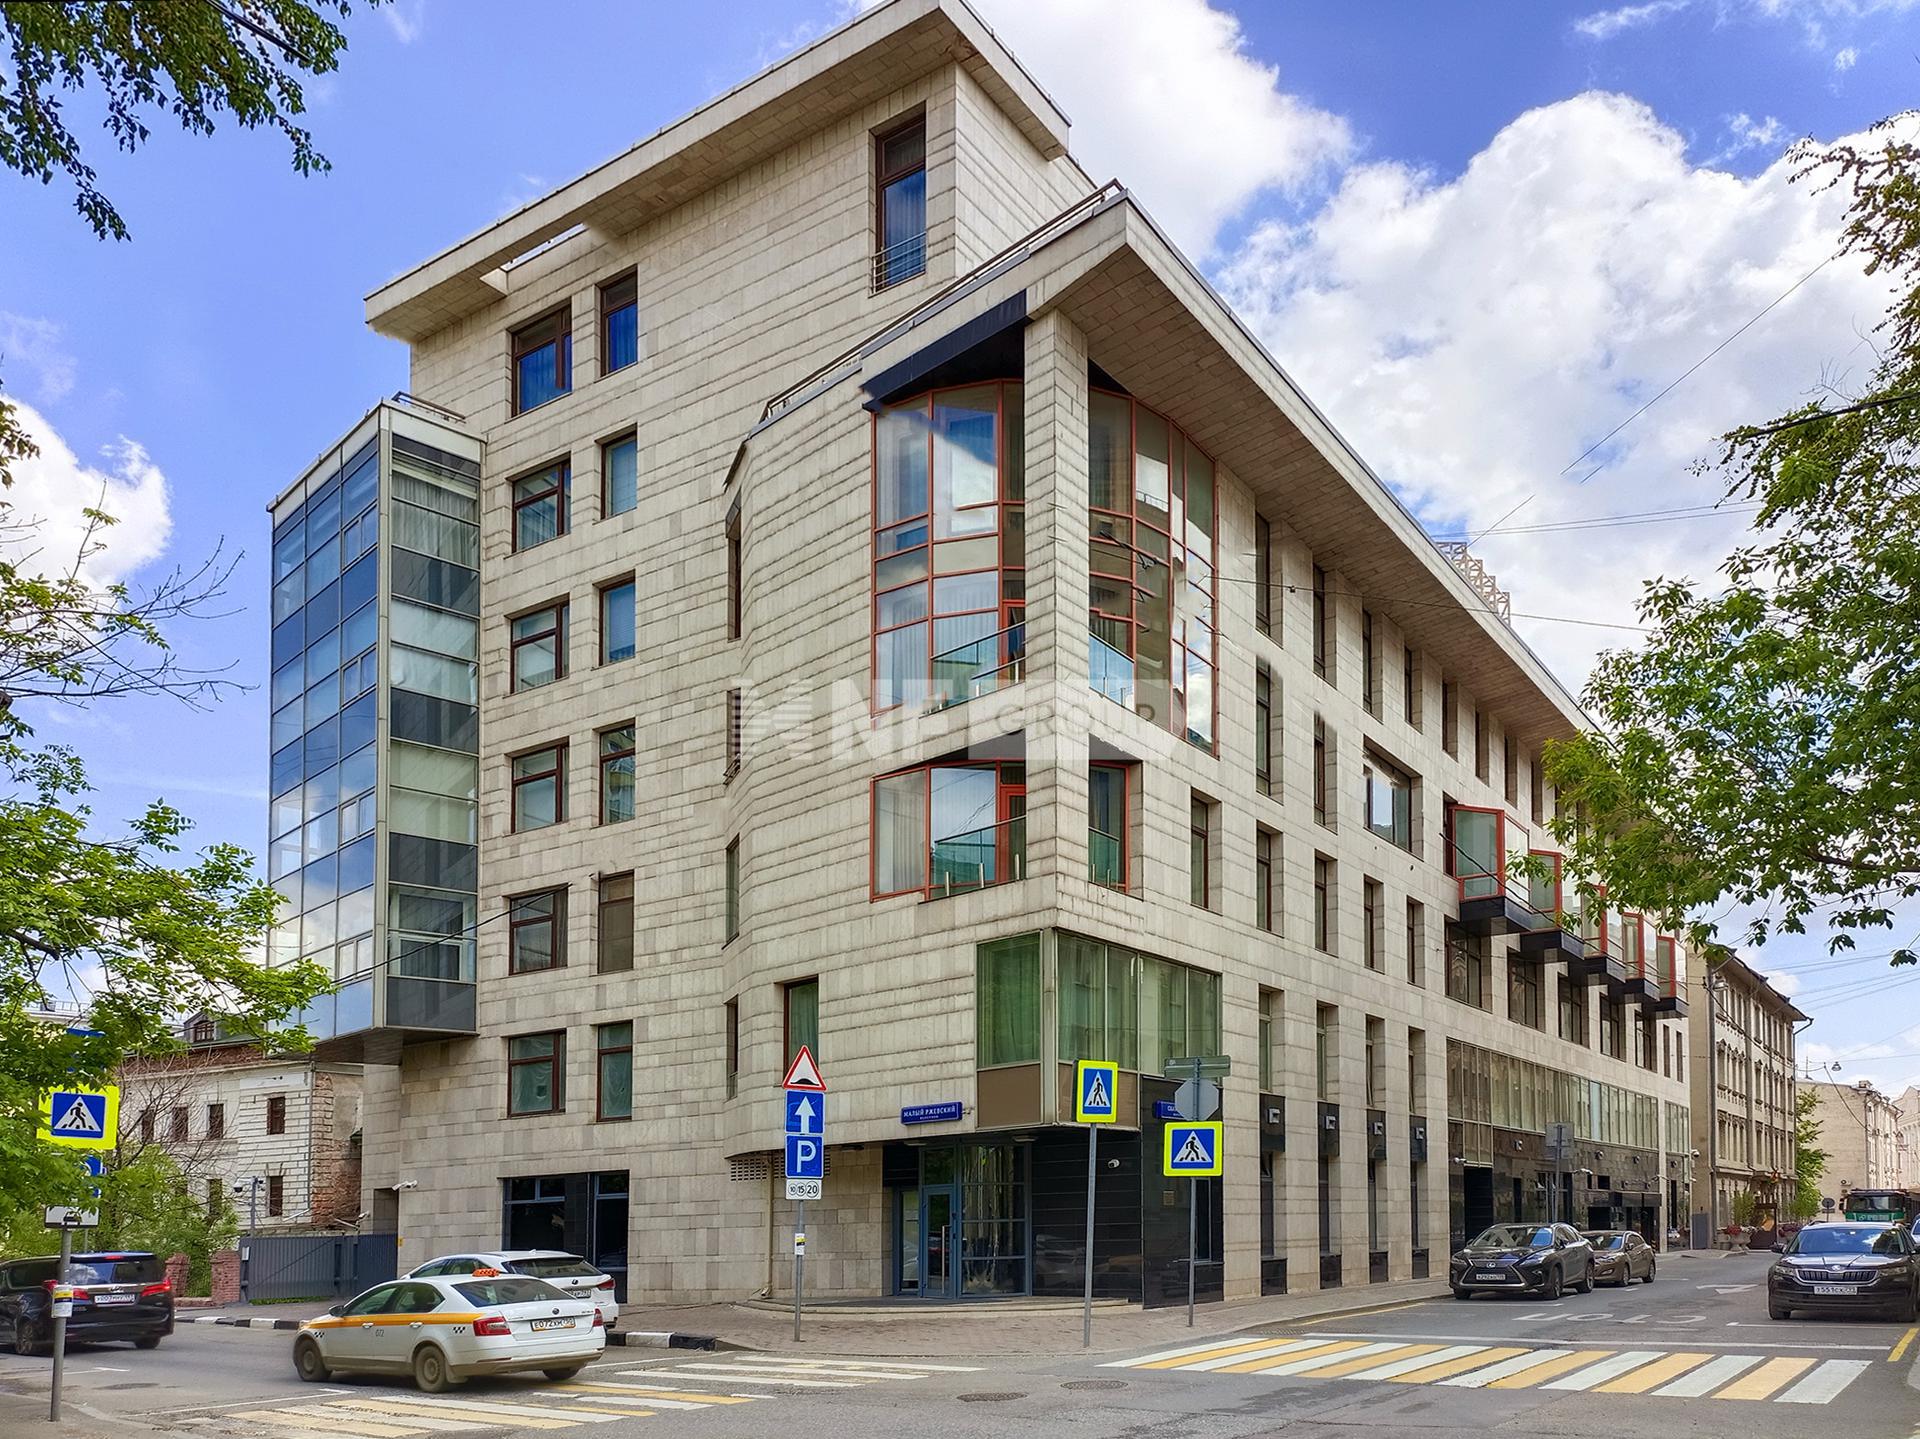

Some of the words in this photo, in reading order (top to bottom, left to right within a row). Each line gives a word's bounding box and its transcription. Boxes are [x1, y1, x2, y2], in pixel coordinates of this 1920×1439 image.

[903, 1108, 924, 1118] МАЛЫЙ
[925, 1105, 956, 1115] РЖЕВСКИЙ
[797, 1140, 817, 1173] P
[798, 1185, 805, 1194] 15
[807, 1184, 818, 1194] 20
